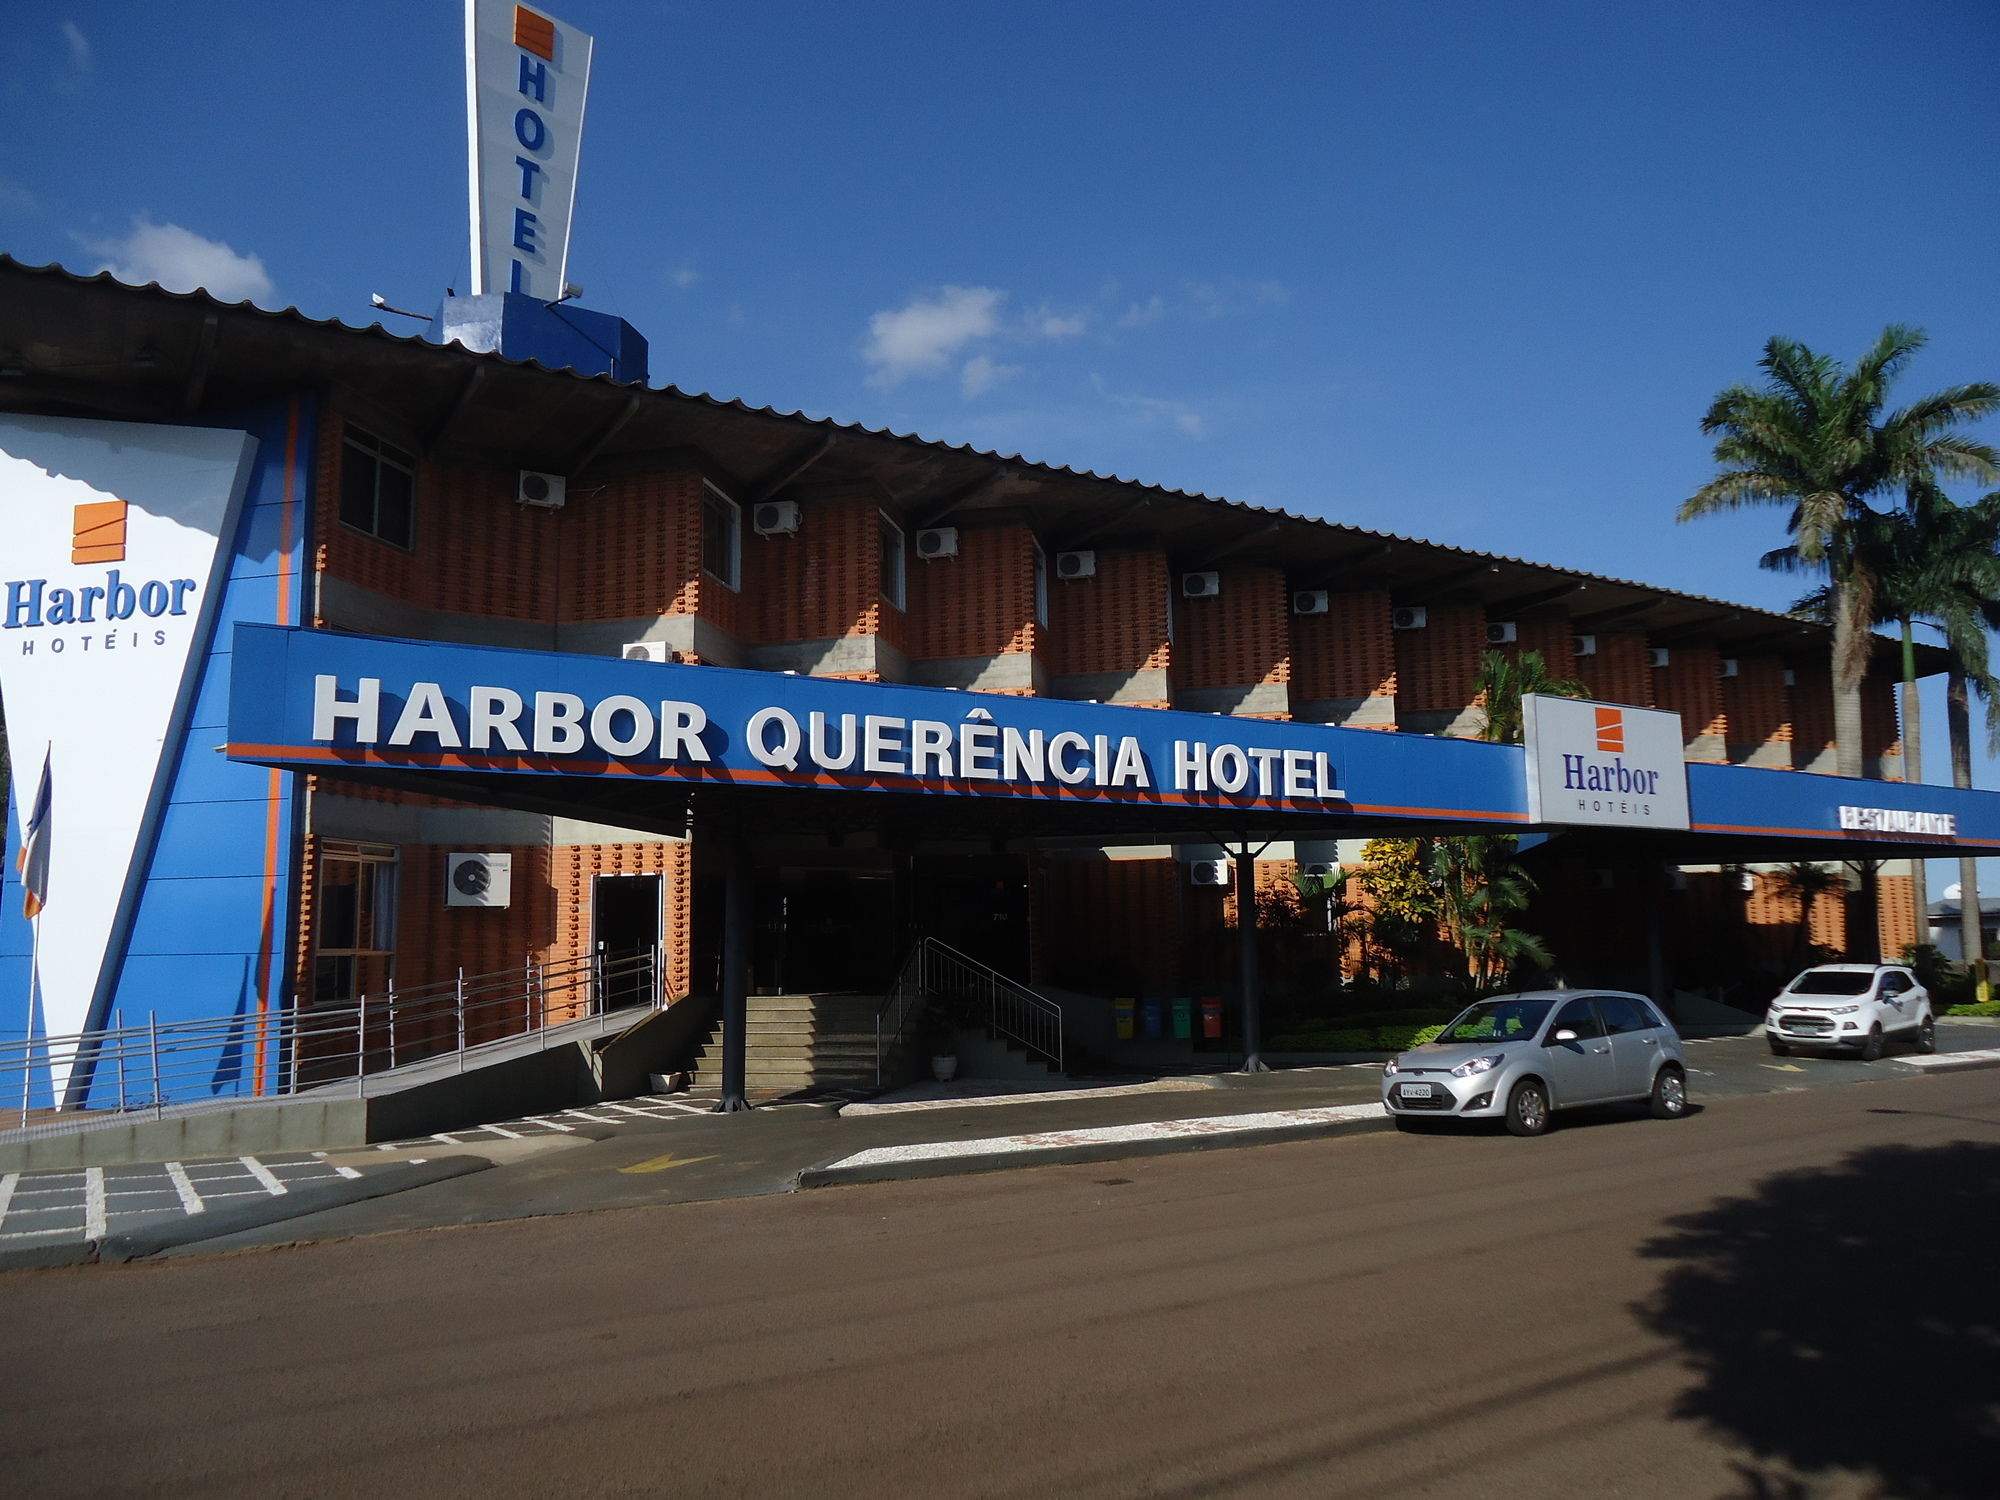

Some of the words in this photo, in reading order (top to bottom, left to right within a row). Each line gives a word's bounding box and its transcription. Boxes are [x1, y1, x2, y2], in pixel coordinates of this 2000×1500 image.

[2, 569, 196, 629] Harbor
[22, 629, 166, 656] HOTÉIS
[313, 673, 712, 762] HARBOR
[745, 706, 1150, 789] QUERÊNCIA
[1174, 739, 1347, 799] HOTEL
[1562, 753, 1659, 795] Harbor
[1578, 799, 1651, 815] HOTÉIS
[1838, 805, 1957, 836] RESTAURANTE
